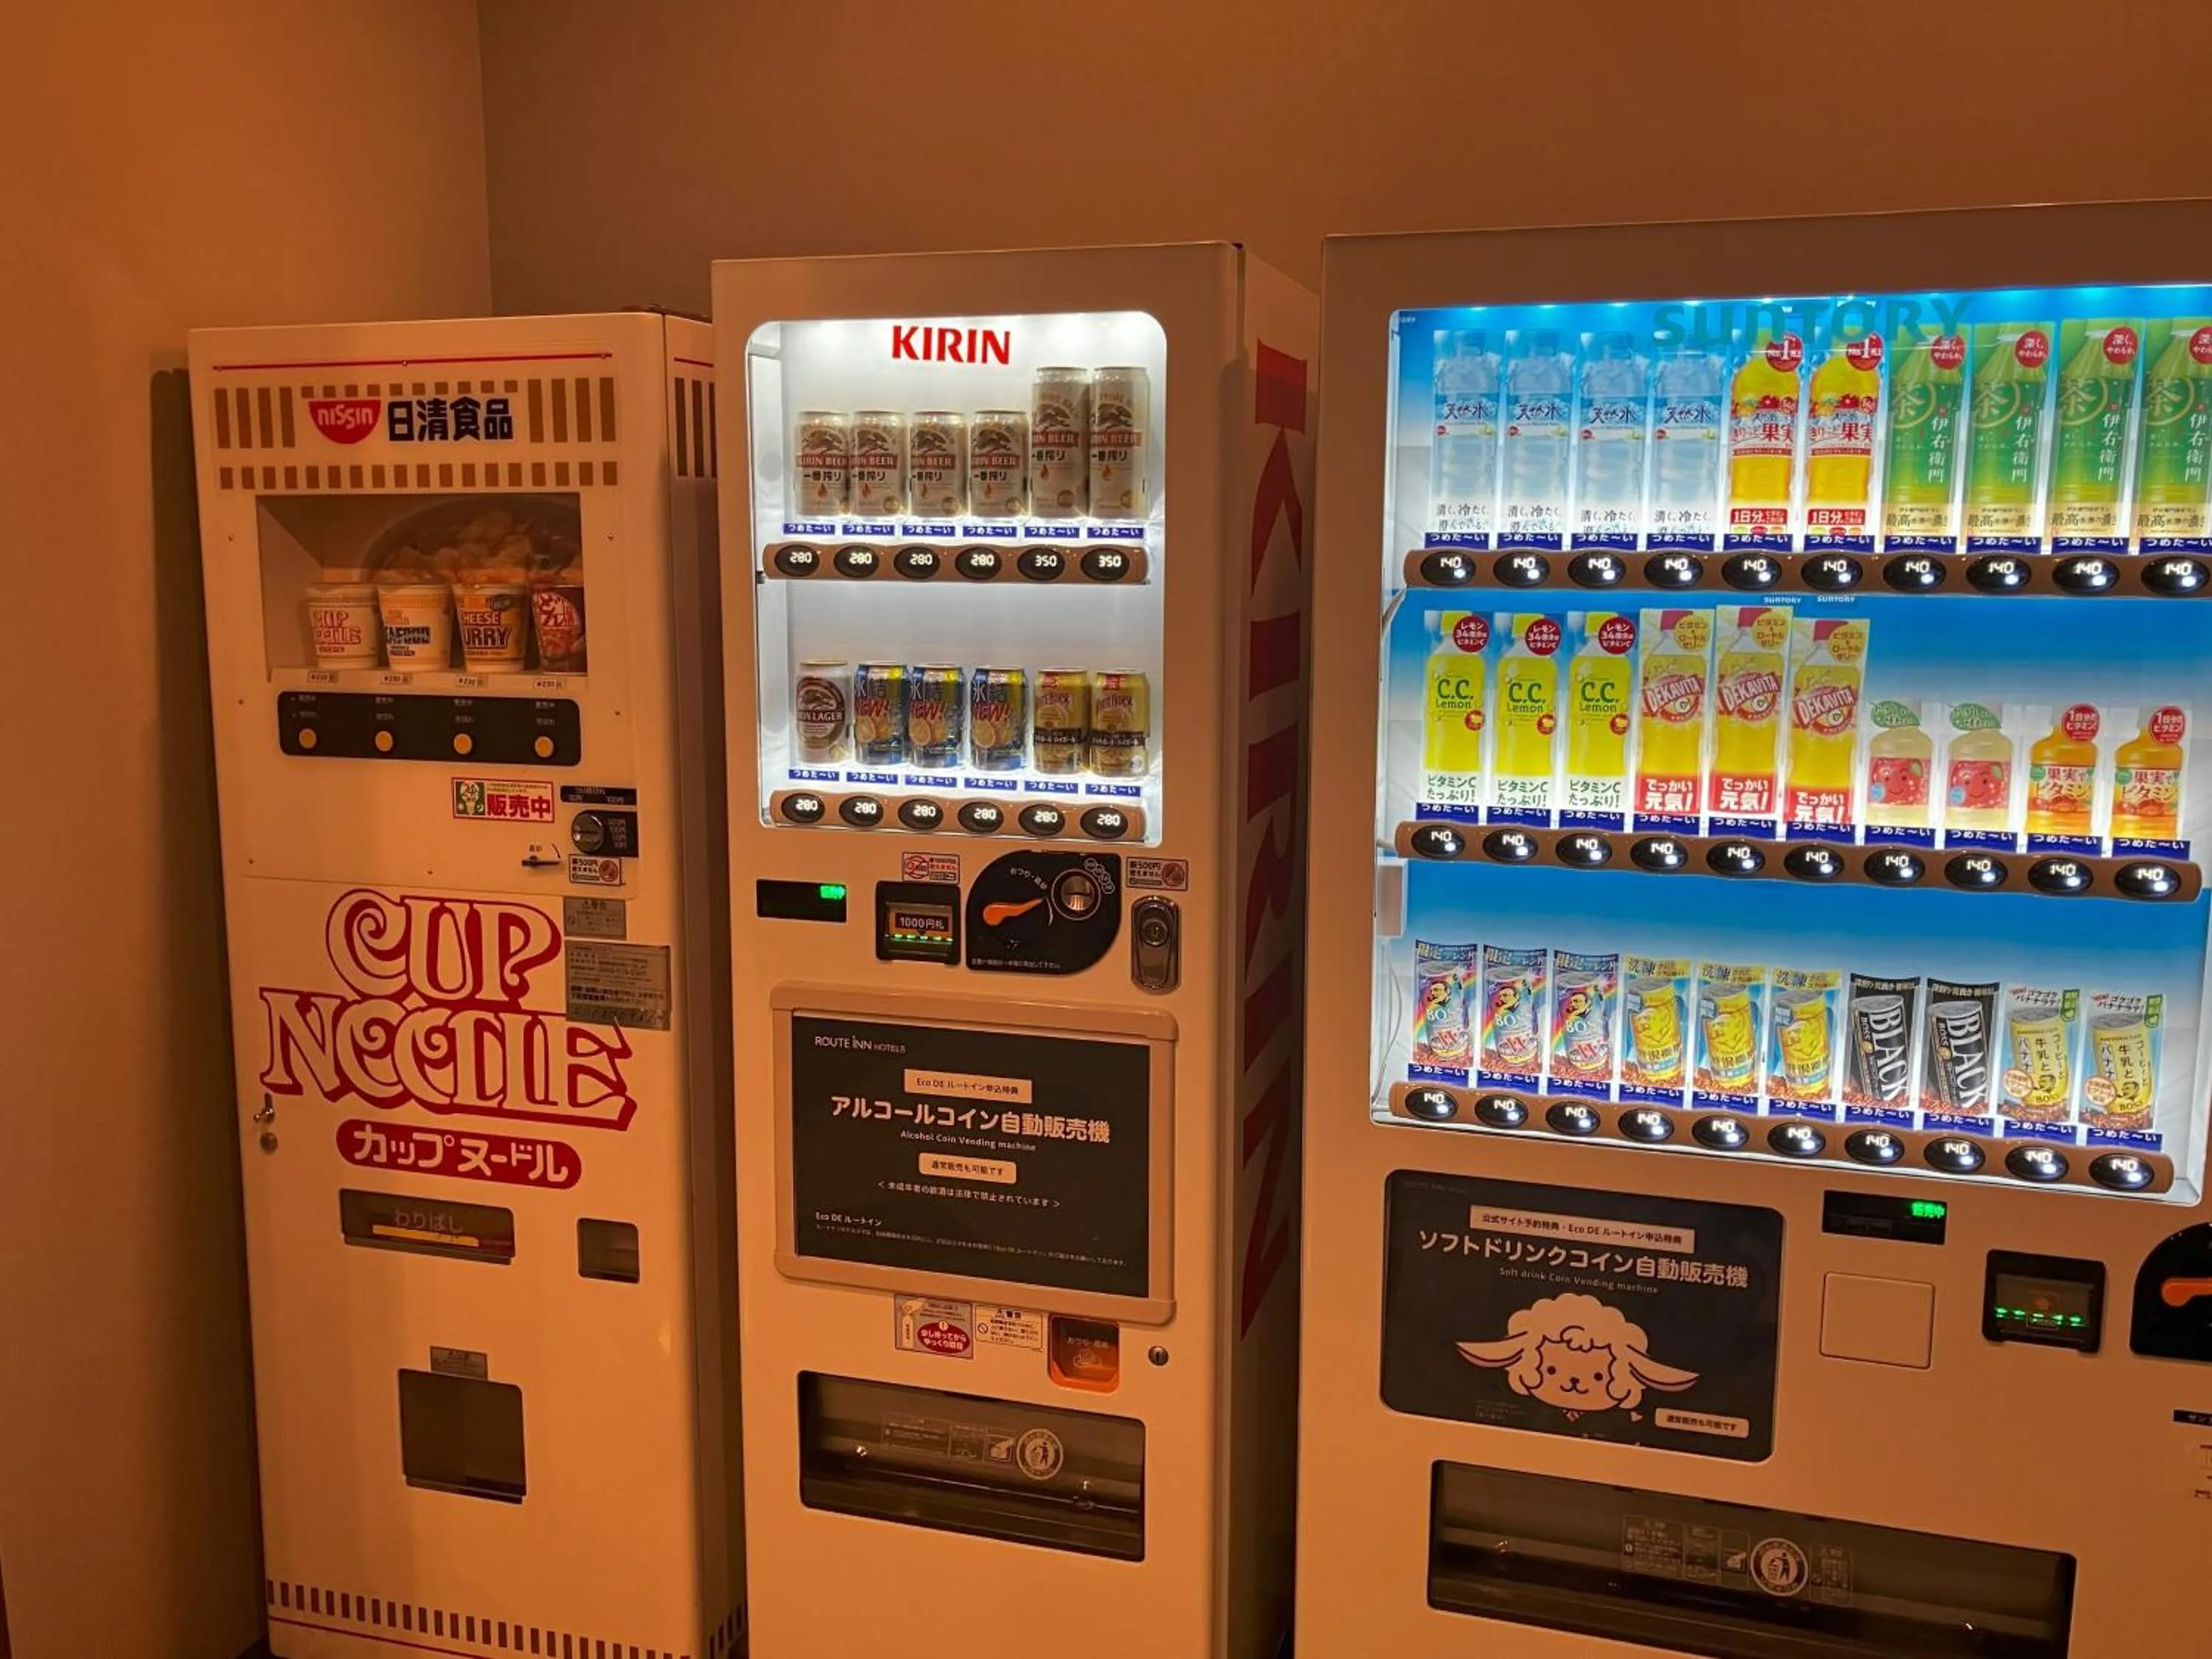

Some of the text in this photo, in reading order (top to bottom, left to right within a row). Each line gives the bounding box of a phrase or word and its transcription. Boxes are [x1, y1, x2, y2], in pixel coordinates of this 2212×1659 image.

[1652, 296, 1972, 347] SUNTORY
[891, 325, 1011, 365] KIRIN
[1444, 403, 1489, 420] 天然水
[1516, 403, 1562, 421] 天然水
[1590, 406, 1637, 424] 天然水
[1663, 406, 1711, 424] 天然水
[387, 395, 514, 442] 日清食品
[1928, 416, 1949, 483] 伊右衛門
[2011, 416, 2032, 483] 伊右衛門
[2098, 412, 2120, 483] 伊右衛門
[2185, 413, 2208, 483] 伊右衛門
[1032, 449, 1065, 461] 一番搾り
[1092, 450, 1127, 461] 一番搾り
[804, 471, 841, 481] 一番搾り
[852, 471, 885, 481] 一番搾り
[912, 471, 942, 481] 一番搾り
[974, 471, 1007, 481] 一番搾り
[1733, 509, 1764, 523] 1日分
[1812, 510, 1843, 524] 1日分
[790, 552, 811, 563] 280
[849, 552, 872, 563] 280
[910, 554, 932, 565] 280
[971, 554, 994, 566] 280
[1035, 555, 1057, 567] 350
[1099, 555, 1121, 567] 350
[1441, 557, 1461, 568] 140
[1514, 557, 1536, 568] 140
[1588, 557, 1610, 568] 140
[1665, 557, 1687, 569] 140
[1744, 560, 1766, 571] 140
[1823, 560, 1846, 571] 140
[1906, 560, 1930, 572] 140
[1988, 562, 2014, 573] 140
[2075, 562, 2101, 574] 140
[2165, 563, 2191, 575] 140
[1817, 595, 1855, 603] SUNTORY
[461, 613, 500, 625] HEESE
[462, 627, 510, 647] URRY
[1437, 679, 1474, 699] C.C.
[1508, 683, 1546, 703] C.C.
[1581, 681, 1620, 703] C.C.
[1646, 675, 1700, 713] DEKAVITA
[1721, 675, 1778, 712] DEKAVITA
[1436, 700, 1472, 709] Lemon
[1506, 703, 1544, 713] Lemon
[1579, 702, 1617, 712] Lemon
[1797, 688, 1854, 726] DEKAVITA
[815, 712, 843, 721] LAGER
[1427, 775, 1477, 789] ビタミンC
[1498, 779, 1548, 793] ビタミンC
[1570, 779, 1621, 793] ビタミンC
[1645, 778, 1693, 791] でっかい
[1722, 777, 1768, 791] でっかい
[1427, 787, 1475, 802] たっぷり!
[1497, 793, 1547, 807] たっぷり!
[1568, 793, 1620, 808] たっぷり!
[1795, 790, 1844, 804] でっかい
[487, 793, 551, 818] 販売中
[796, 800, 817, 810] 280
[1645, 792, 1693, 811] 元気!
[1719, 790, 1768, 812] 元気!
[855, 802, 876, 814] 280
[914, 805, 936, 816] 280
[974, 808, 996, 819] 280
[1034, 811, 1057, 823] 280
[1097, 814, 1120, 826] 280
[1430, 831, 1452, 841] 140
[1502, 835, 1524, 846] 140
[1576, 839, 1598, 849] 140
[1651, 844, 1673, 854] 140
[1728, 847, 1750, 858] 140
[1806, 852, 1829, 863] 140
[1130, 860, 1161, 870] 新500円
[1885, 856, 1908, 867] 140
[1966, 860, 1990, 871] 140
[2051, 865, 2075, 876] 140
[2138, 869, 2163, 880] 140
[899, 917, 945, 930] 1000円札
[326, 888, 561, 1009] CUP
[815, 1036, 850, 1048] ROUTE
[874, 1043, 906, 1054] HOTELS
[260, 987, 638, 1131] NOODLE
[1868, 1006, 1909, 1102] BLACK
[2018, 1037, 2031, 1071] バナナ
[2035, 1037, 2051, 1072] 牛乳と
[1947, 1013, 1988, 1108] BLACK
[2101, 1044, 2114, 1079] バナナ
[2118, 1045, 2133, 1079] 牛乳と
[917, 1077, 931, 1087] Eco
[1424, 1093, 1444, 1103] 140
[2036, 1093, 2059, 1104] BOSS
[1494, 1099, 1515, 1110] 140
[2119, 1100, 2143, 1111] BOSS
[1565, 1107, 1587, 1118] 140
[1638, 1113, 1659, 1124] 140
[832, 1096, 1110, 1144] アルコールコイン自動販売機
[1711, 1121, 1733, 1132] 140
[1788, 1127, 1811, 1138] 140
[900, 1130, 1036, 1151] Alcohol Coin Vending machine
[1866, 1135, 1890, 1147] 140
[353, 1125, 568, 1183] カップヌードル
[1944, 1143, 1969, 1155] 140
[2025, 1150, 2052, 1162] 140
[931, 1160, 1003, 1175] 通常販売も可能です
[2111, 1159, 2138, 1171] 140
[392, 1207, 464, 1233] わりばし
[815, 1211, 882, 1227] Eco DE ルートイン
[1568, 1222, 1585, 1234] Eco
[1586, 1224, 1600, 1237] DE
[1601, 1226, 1683, 1246] ルートイン申込特典
[1419, 1229, 1749, 1289] ソフトドリンクコイン自動販売機
[1499, 1266, 1659, 1294] Soft drink Coin Vending machine
